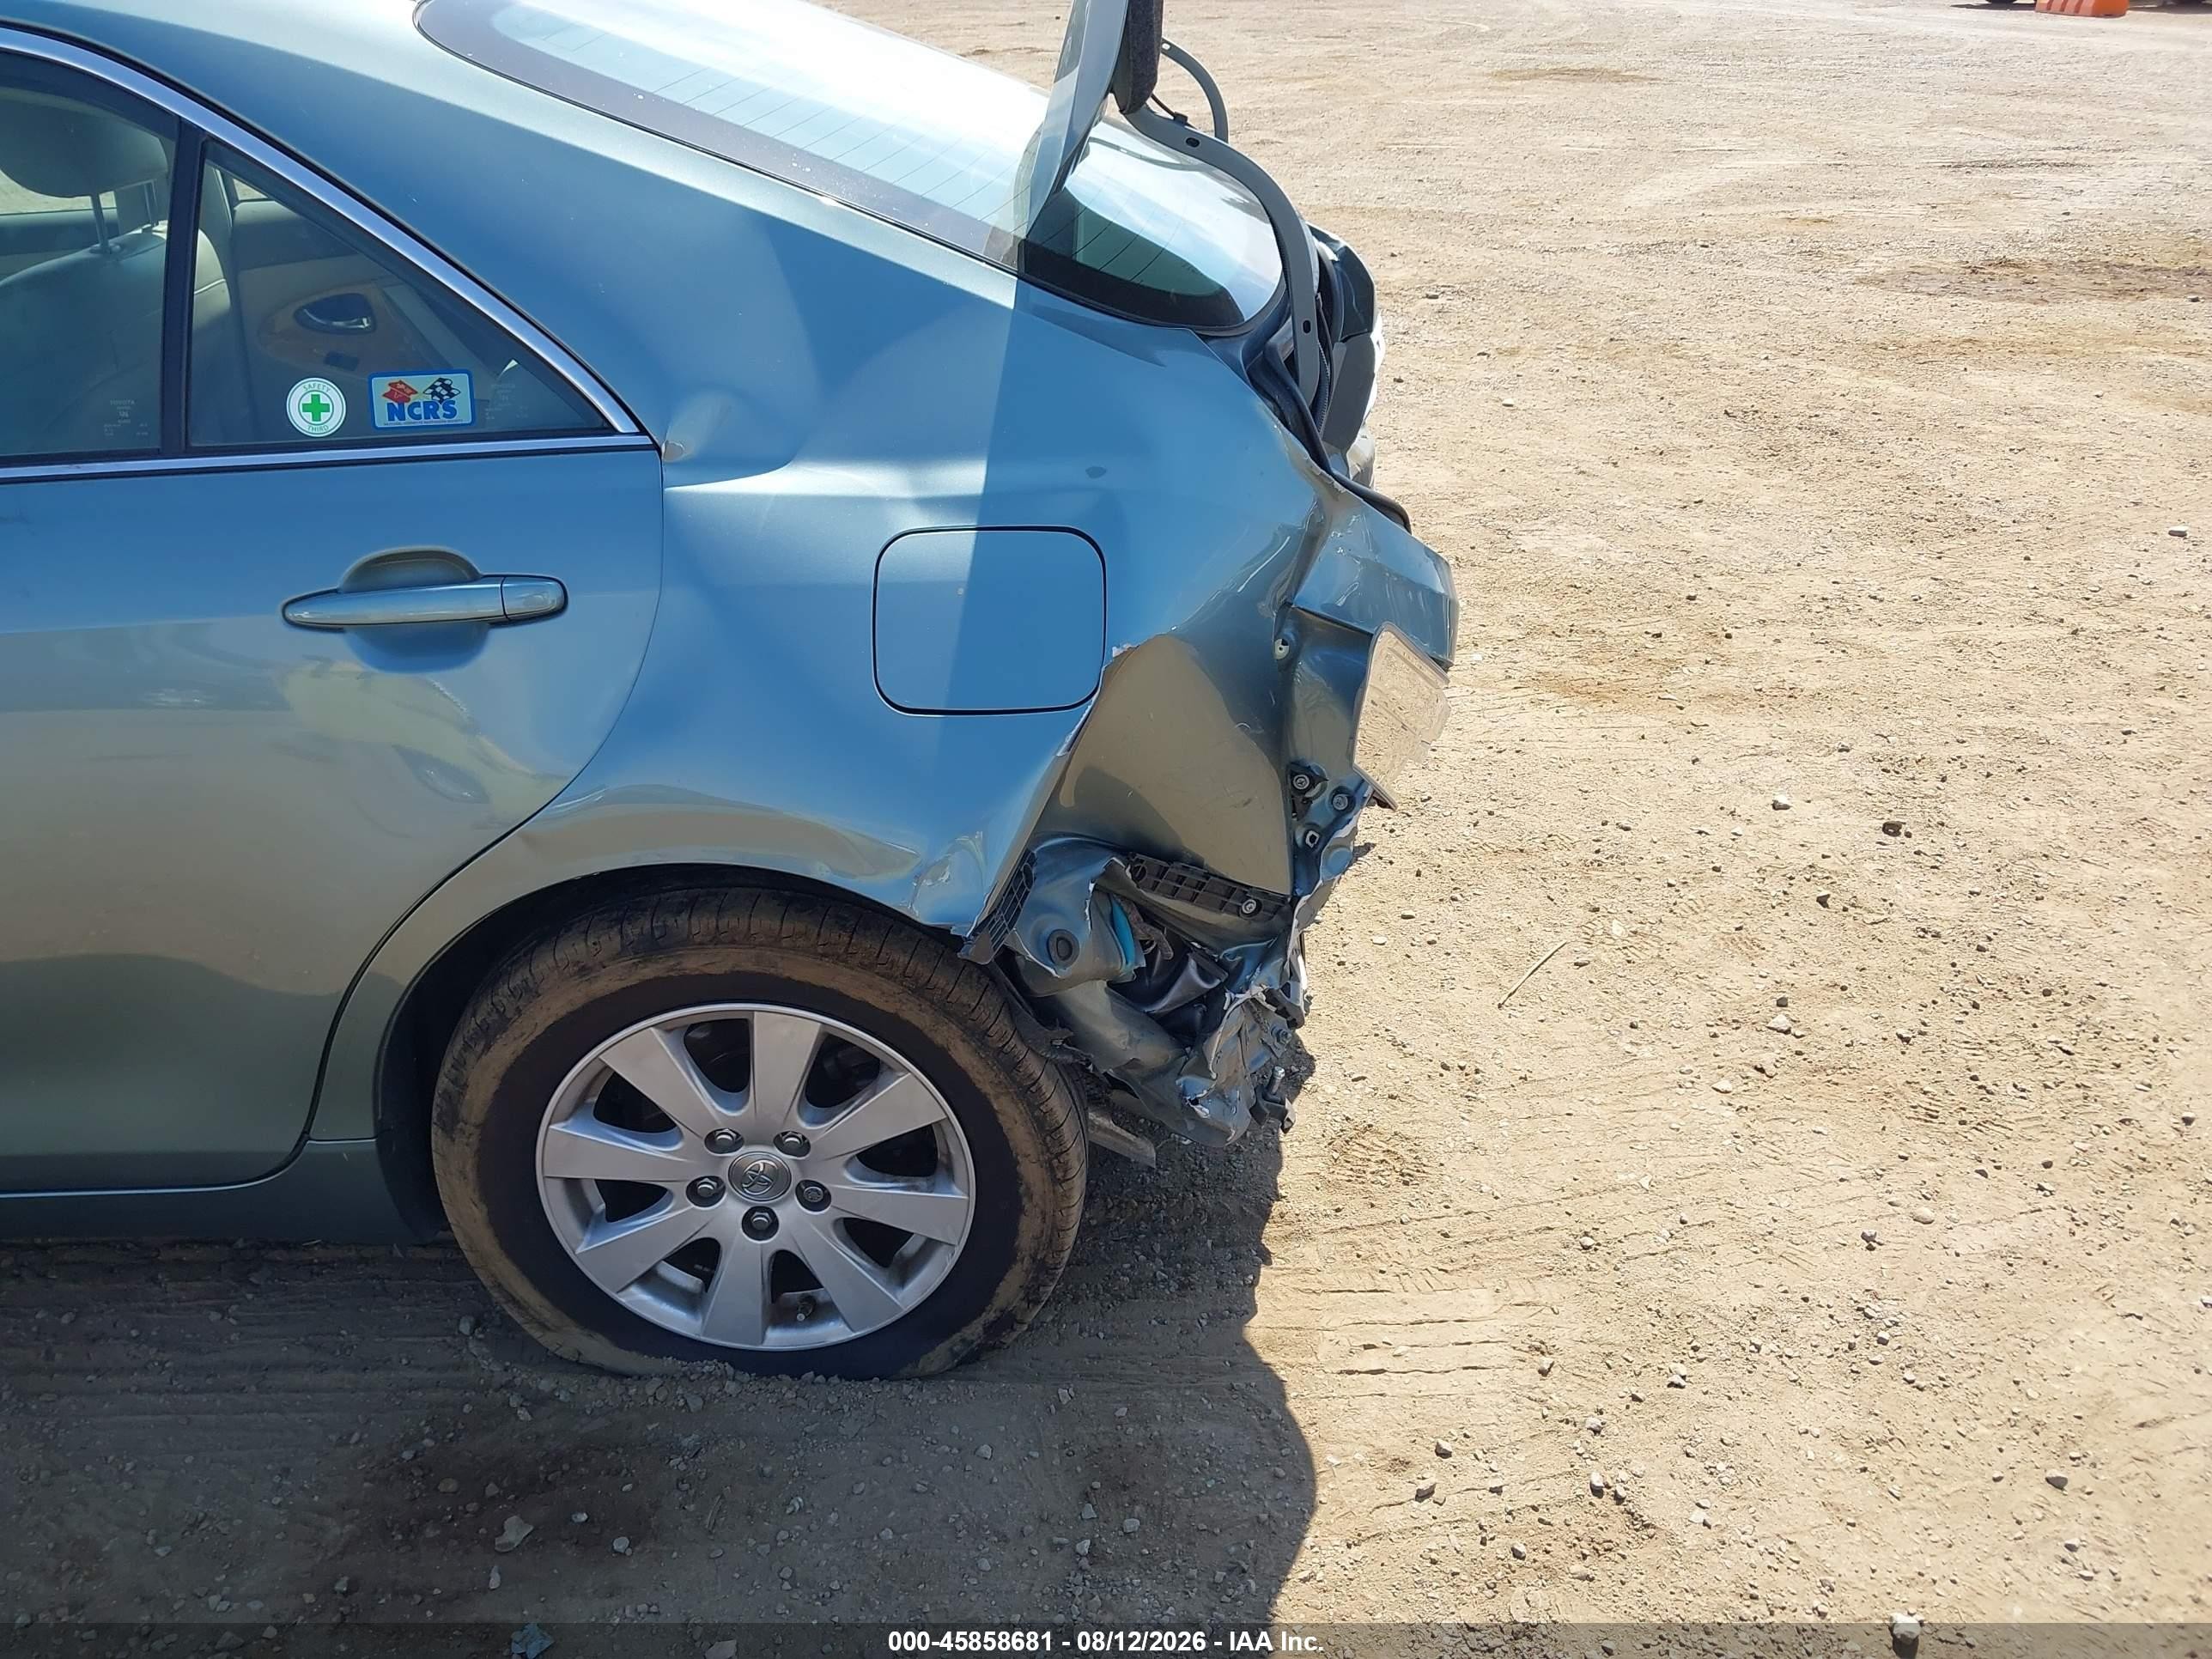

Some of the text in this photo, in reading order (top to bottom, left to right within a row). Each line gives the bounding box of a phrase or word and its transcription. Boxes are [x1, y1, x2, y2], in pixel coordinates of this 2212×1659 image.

[302, 383, 331, 392] SAFETY
[386, 400, 458, 422] NCRS
[307, 424, 330, 433] THIRD
